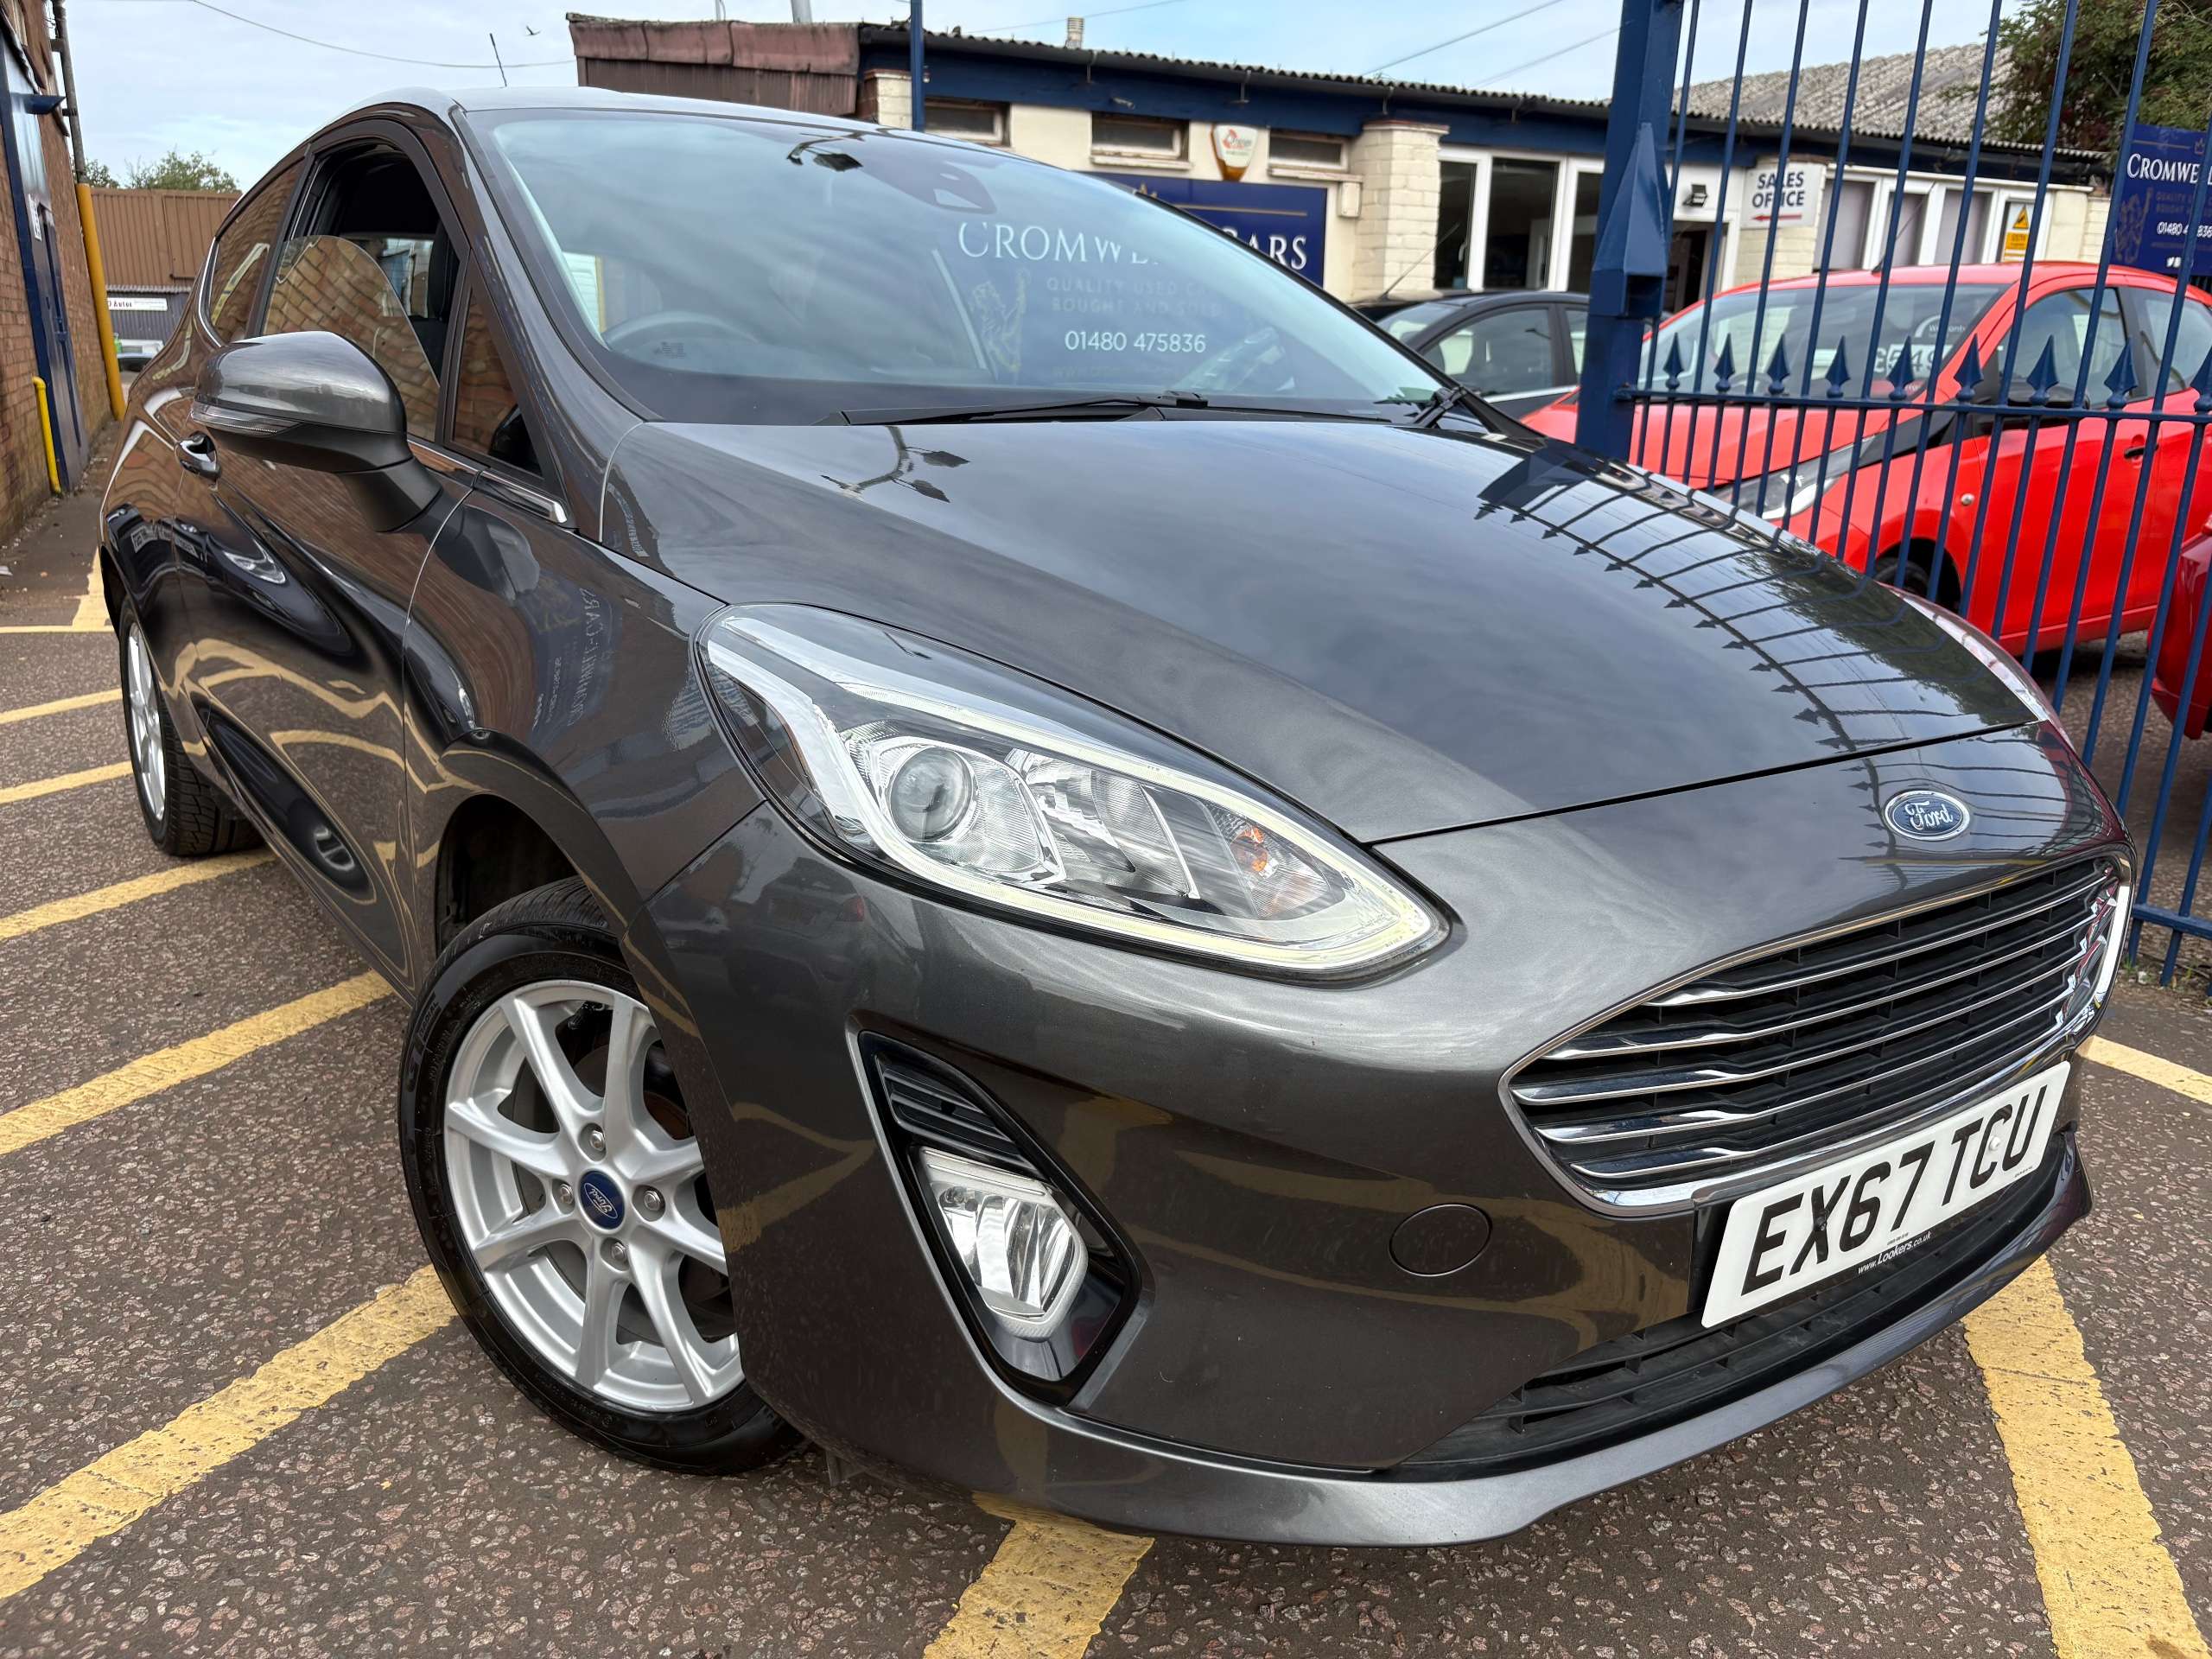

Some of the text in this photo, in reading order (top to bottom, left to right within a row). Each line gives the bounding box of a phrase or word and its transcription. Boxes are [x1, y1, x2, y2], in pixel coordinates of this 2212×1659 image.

[1758, 171, 1804, 189] SAES
[1752, 191, 1805, 207] OFICE
[1065, 330, 1206, 353] 01480 475836
[1904, 800, 1954, 830] Ford
[589, 1188, 613, 1214] Ford
[1741, 1084, 2048, 1297] EX67 TCU
[1857, 1230, 1932, 1275] www.Lookers.co.uk
